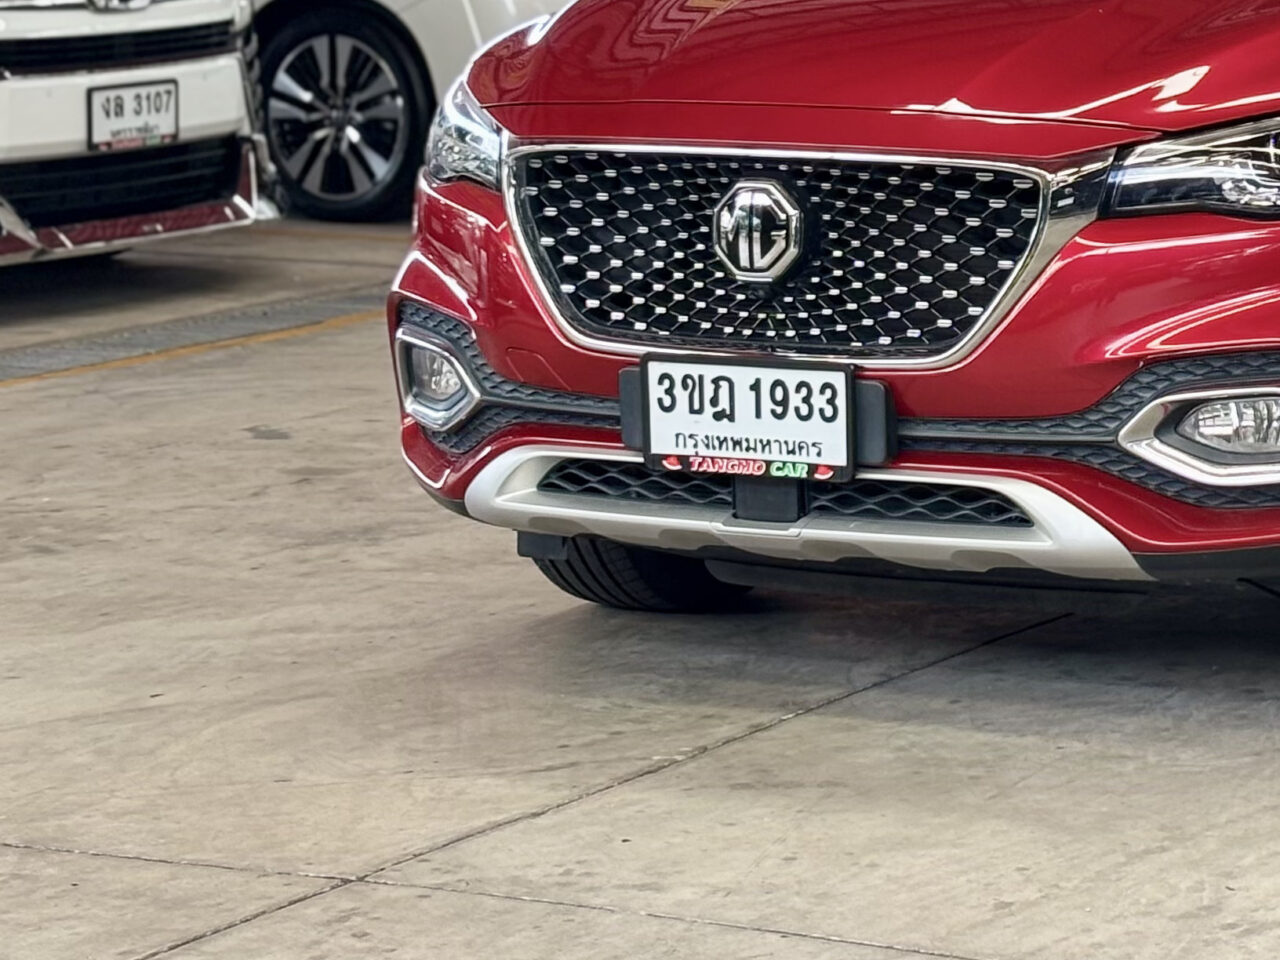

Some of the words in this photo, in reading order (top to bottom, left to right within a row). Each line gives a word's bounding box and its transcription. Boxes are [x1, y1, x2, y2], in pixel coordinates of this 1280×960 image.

[133, 89, 173, 116] 3107
[720, 191, 787, 269] MG
[656, 372, 736, 423] 3ขฎ
[749, 377, 839, 423] 1933
[674, 431, 823, 458] กรุงเทพมหานคร
[689, 456, 767, 476] TANGMO
[769, 461, 809, 478] CAR
